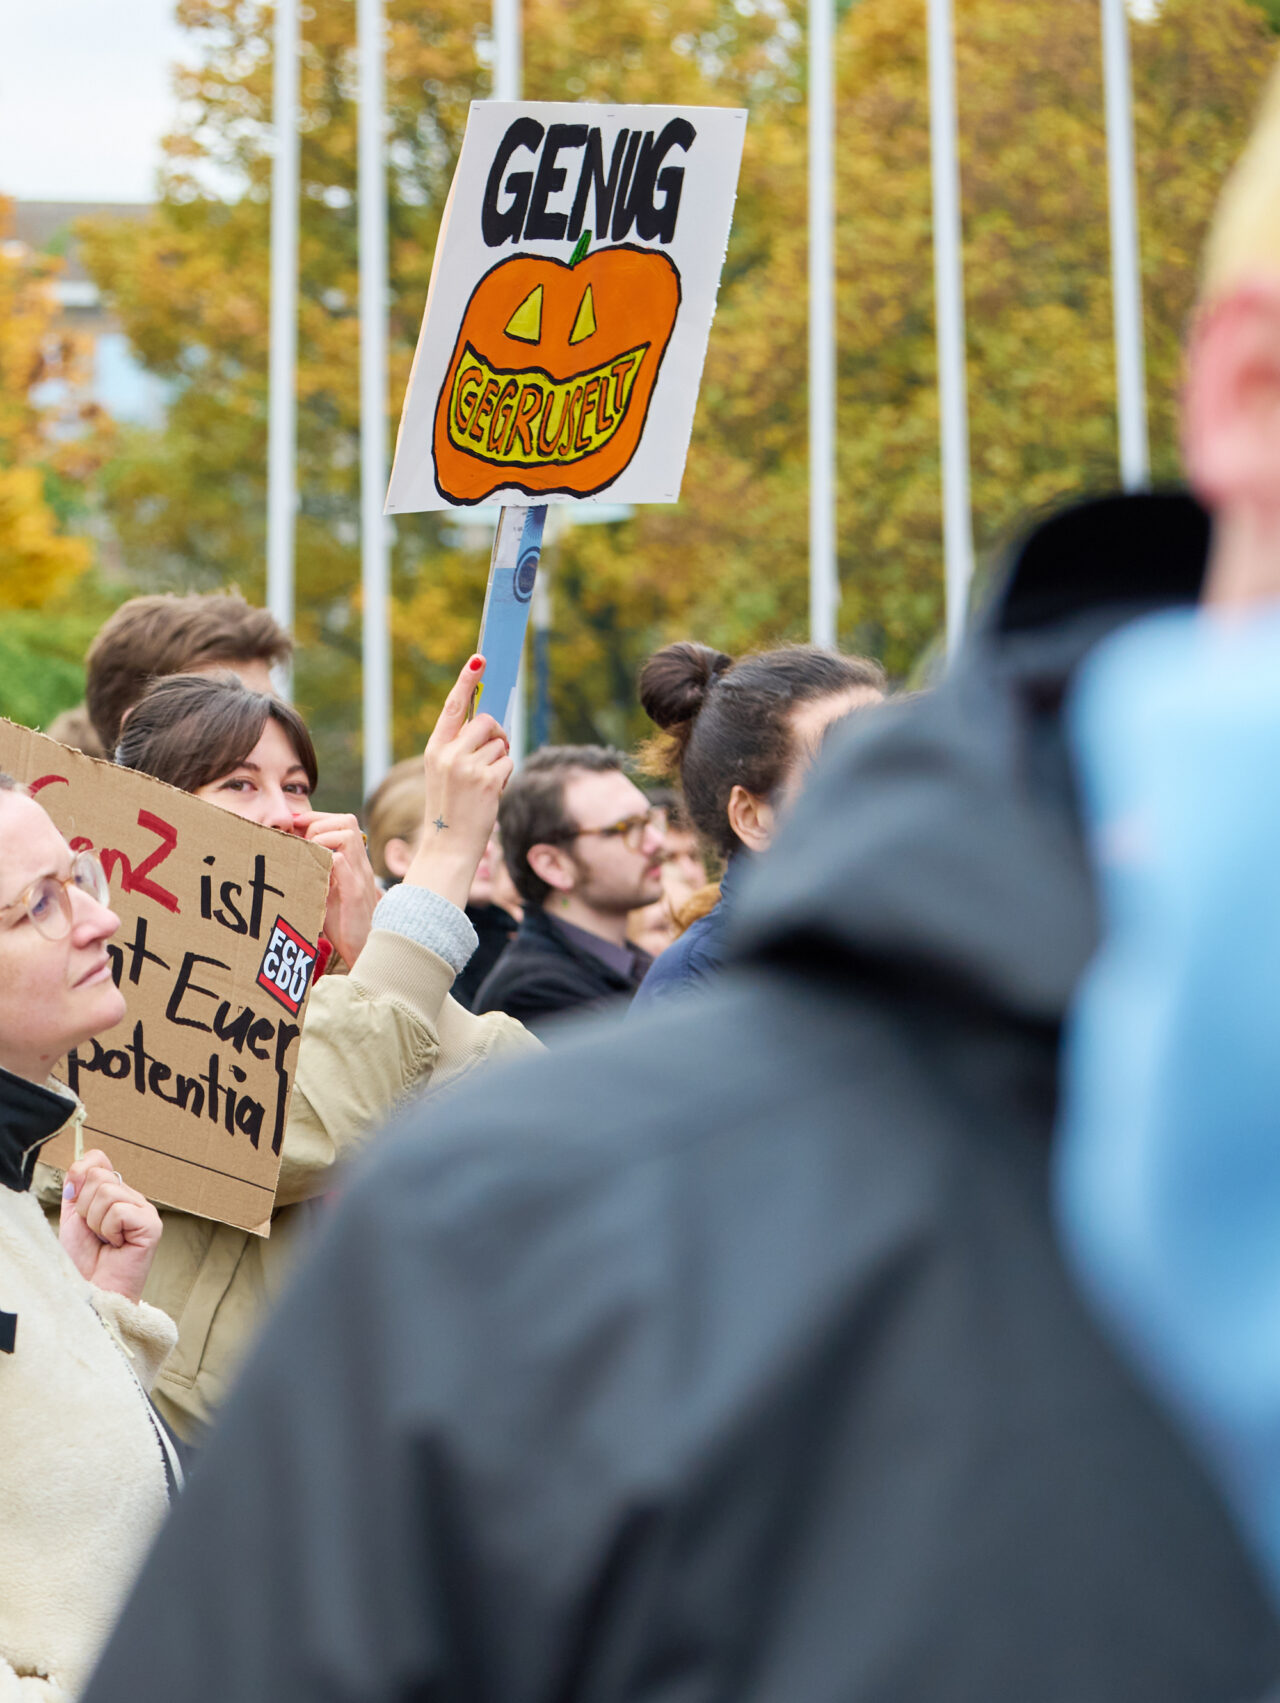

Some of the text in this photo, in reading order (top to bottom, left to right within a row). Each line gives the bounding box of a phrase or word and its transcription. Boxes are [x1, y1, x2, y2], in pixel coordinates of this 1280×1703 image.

[481, 117, 697, 247] GENUG
[455, 359, 635, 457] GEGRUSELT
[201, 855, 284, 940] ist
[263, 952, 307, 1003] CDU
[269, 927, 313, 979] FCK
[166, 952, 300, 1076] Euer
